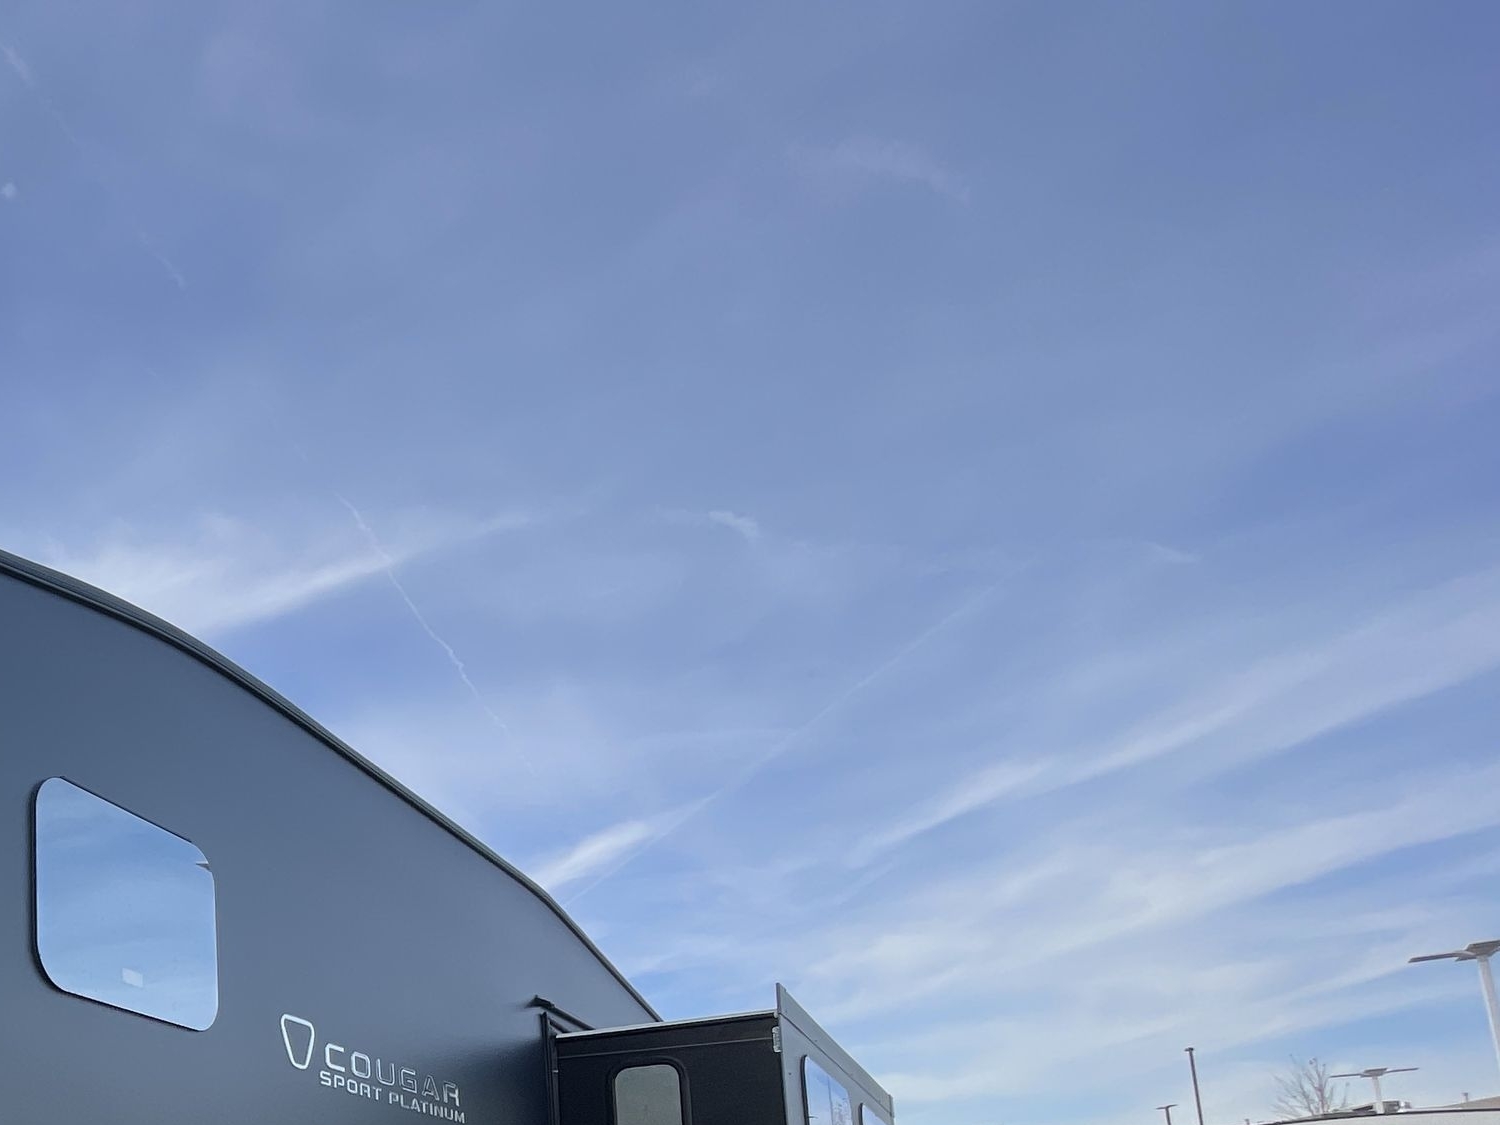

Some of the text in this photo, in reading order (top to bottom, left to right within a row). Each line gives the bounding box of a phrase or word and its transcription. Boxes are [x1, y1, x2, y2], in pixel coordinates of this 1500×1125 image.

[319, 1070, 467, 1125] SPORT PLATINUM
[324, 1043, 461, 1107] COUGAR
